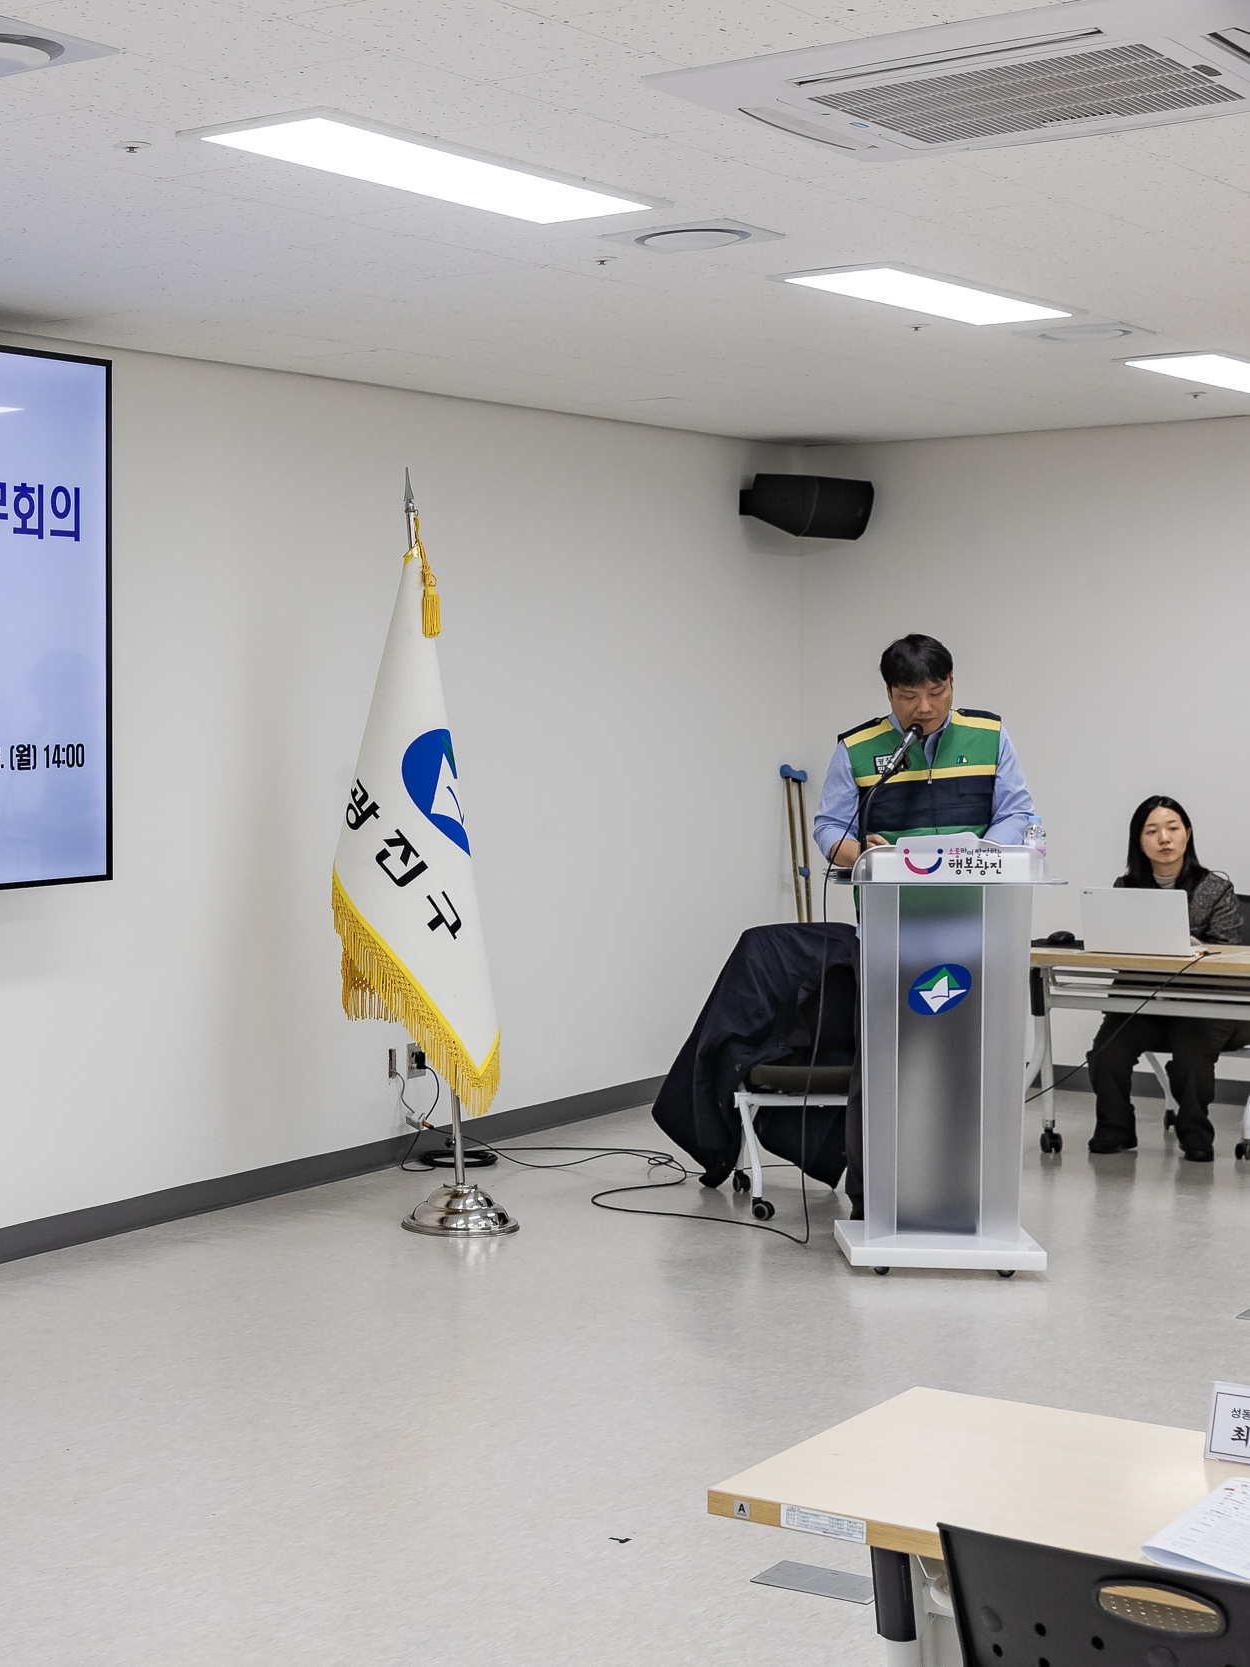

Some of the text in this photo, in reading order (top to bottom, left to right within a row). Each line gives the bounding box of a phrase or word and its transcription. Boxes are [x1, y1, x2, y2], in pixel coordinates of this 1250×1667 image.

[9, 743, 37, 771] (월)
[43, 743, 85, 769] 14:00
[346, 778, 462, 940] 광진구
[948, 857, 1002, 876] 행복광진
[738, 1503, 746, 1514] A
